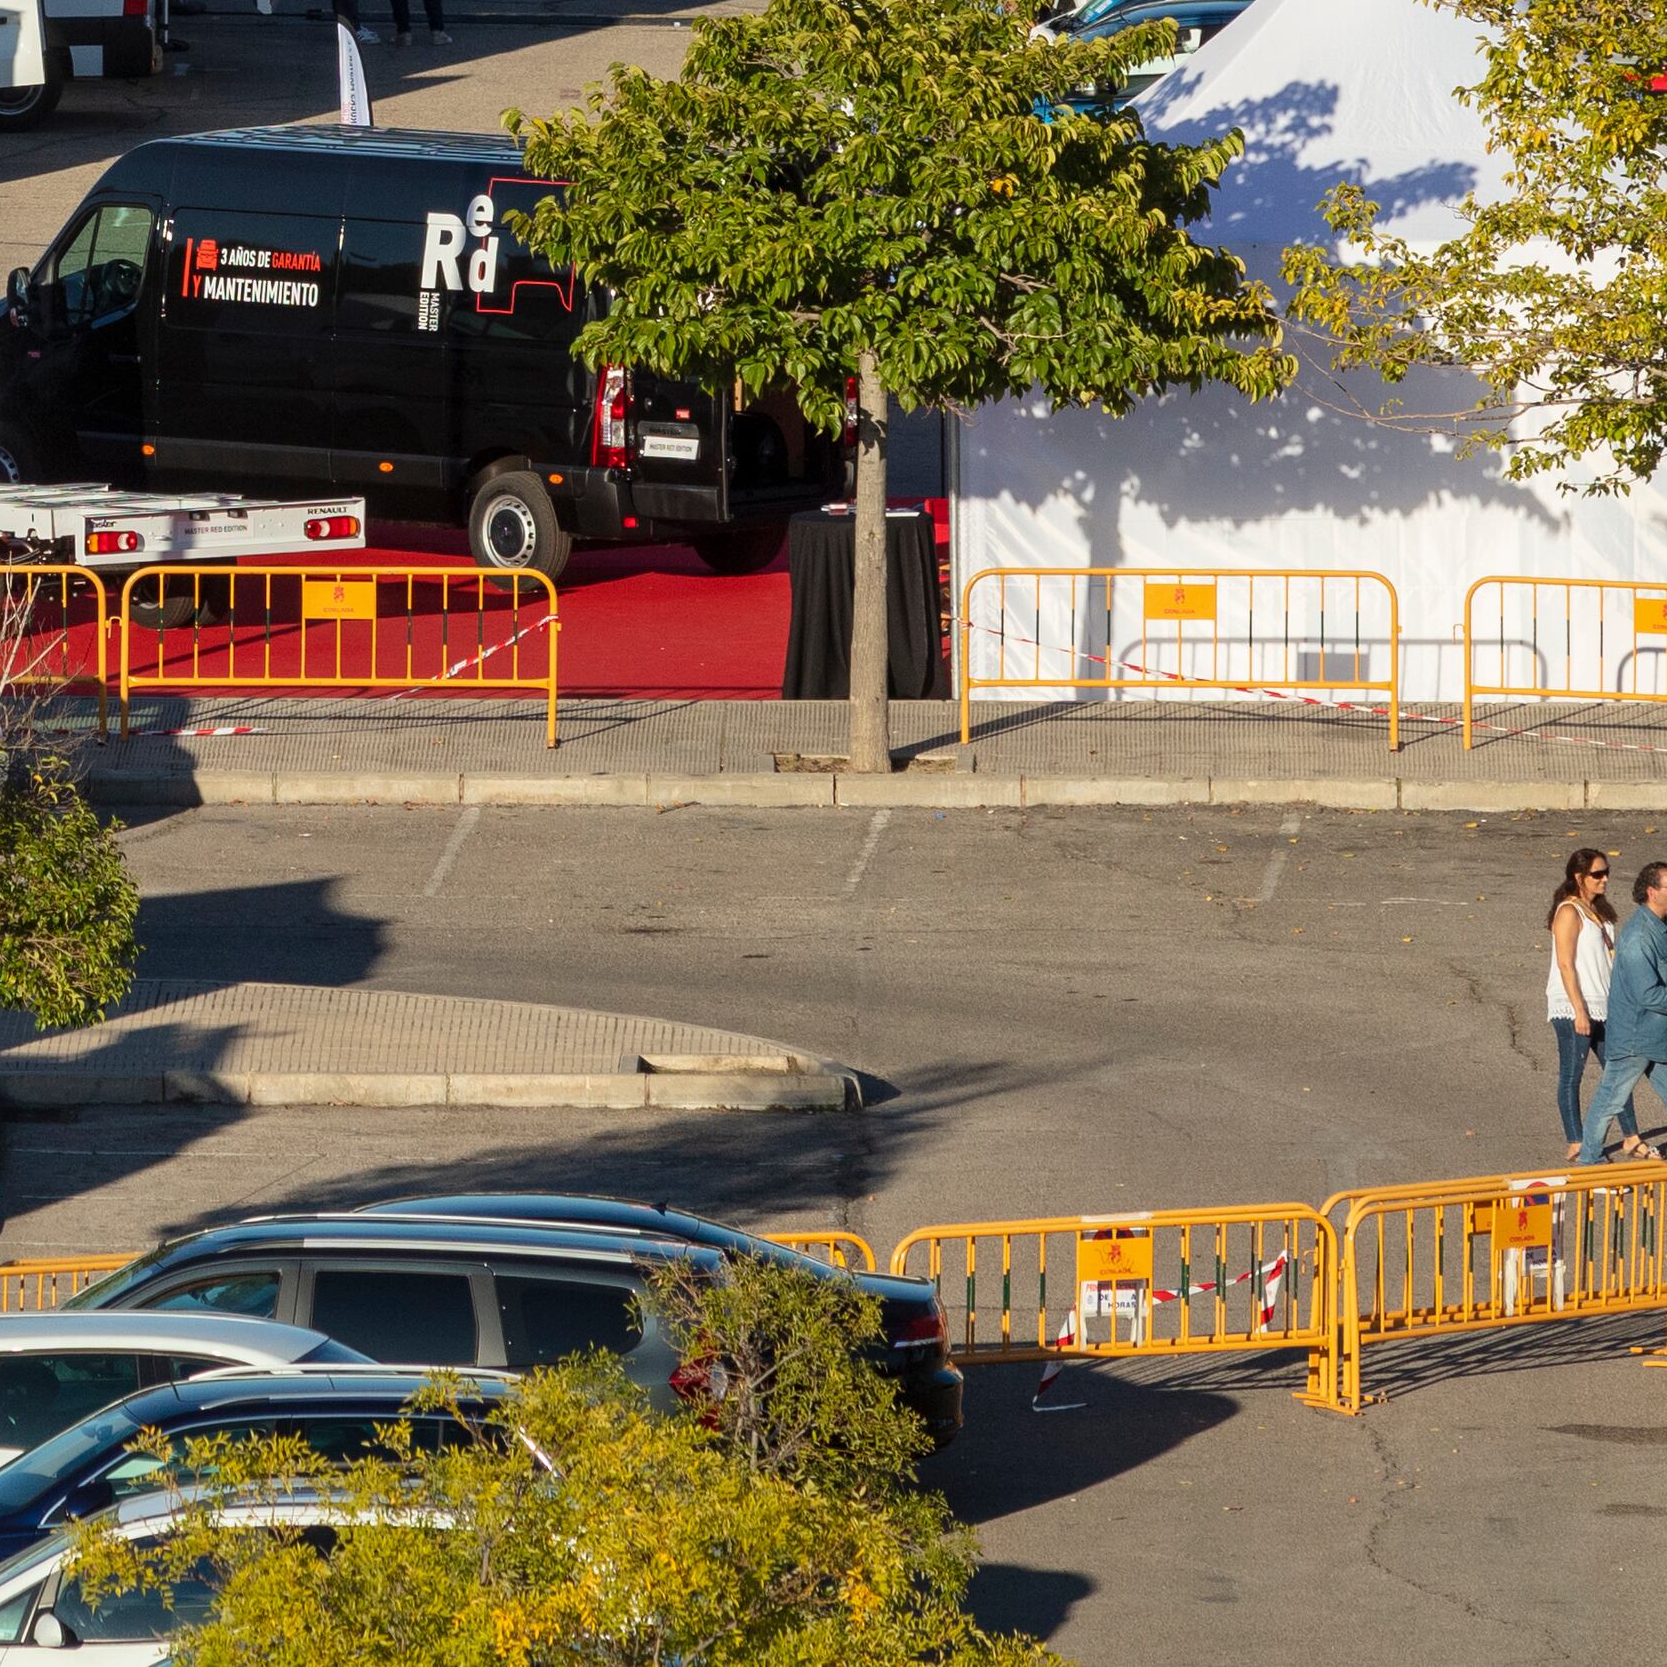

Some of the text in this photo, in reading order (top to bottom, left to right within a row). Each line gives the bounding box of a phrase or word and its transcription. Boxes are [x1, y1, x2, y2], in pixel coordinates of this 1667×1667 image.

[220, 246, 321, 272] 3 AÑOS DE GARANTÍA
[193, 274, 318, 307] Y MANTENIMIENTO
[418, 291, 430, 330] EDITION
[429, 292, 440, 332] MASTER
[307, 506, 348, 515] RENAULT
[184, 525, 247, 535] MASTER RED EDITION
[1509, 1235, 1535, 1243] COSLADA
[1099, 1267, 1131, 1276] COSLADA
[1098, 1293, 1137, 1301] DE A
[1107, 1301, 1137, 1309] HORAS
